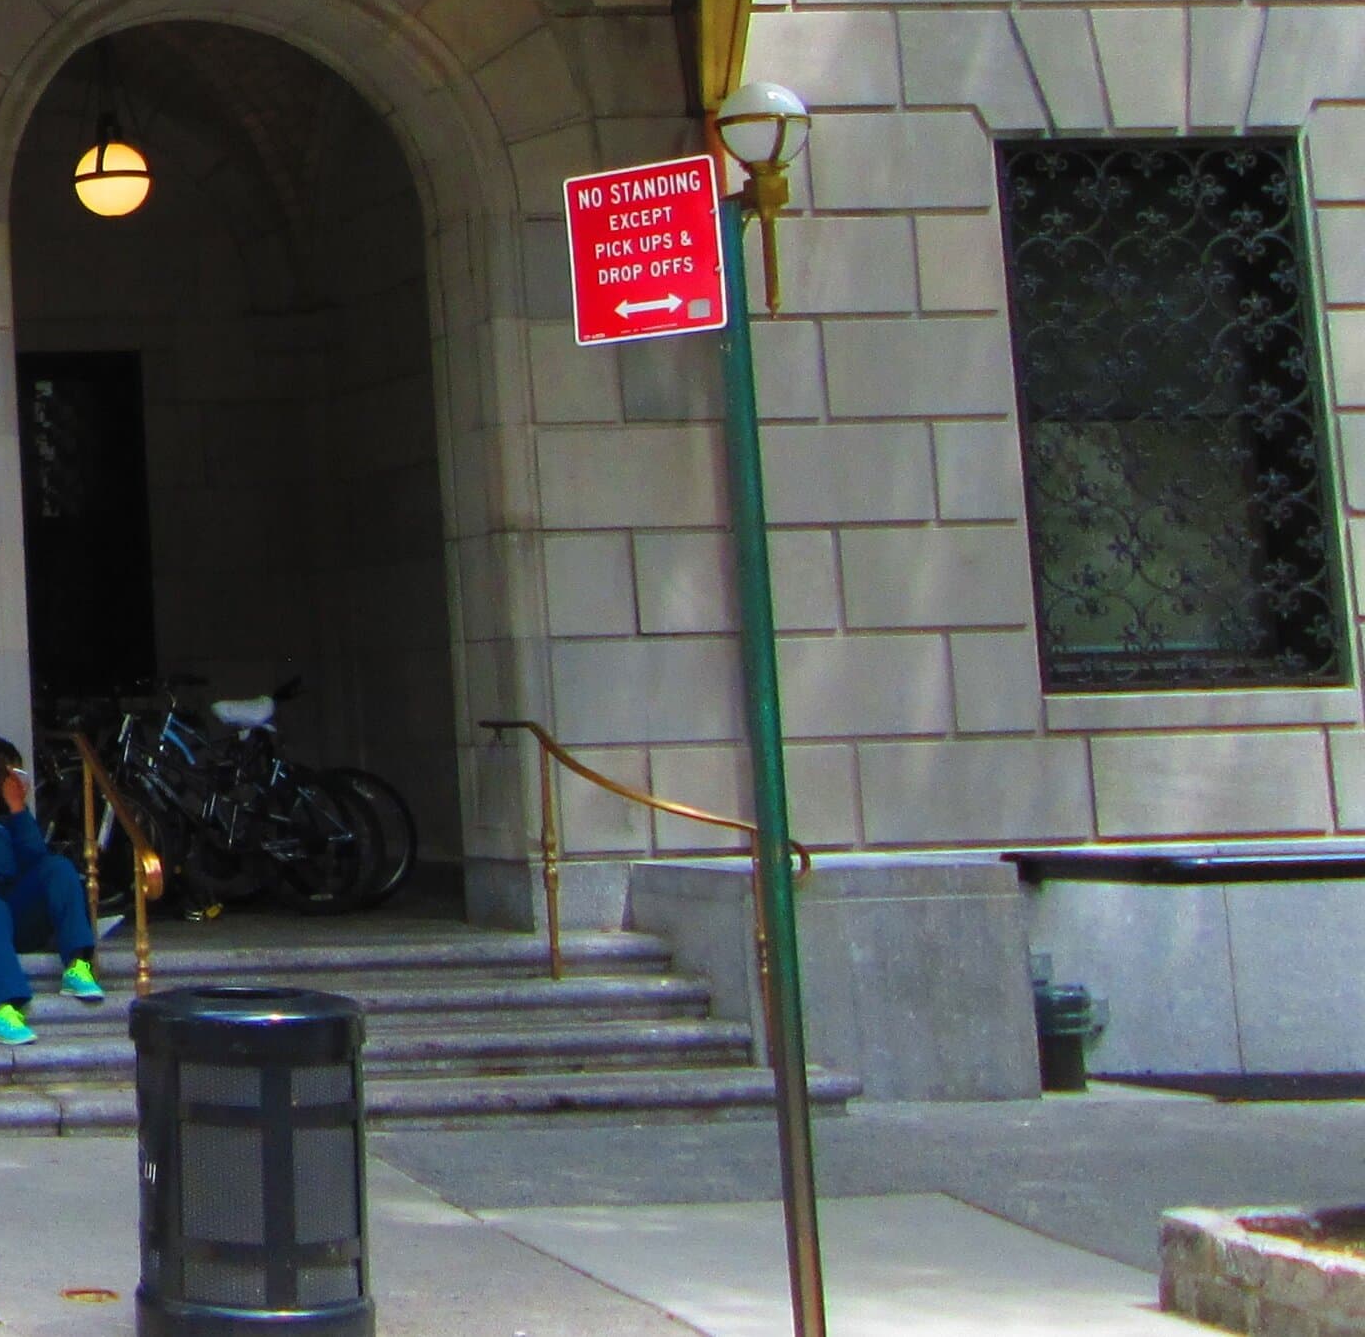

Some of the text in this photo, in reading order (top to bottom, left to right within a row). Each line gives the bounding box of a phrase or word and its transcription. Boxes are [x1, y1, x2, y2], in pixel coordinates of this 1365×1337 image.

[577, 170, 701, 211] NO STANDING
[608, 205, 673, 232] EXCEPT
[594, 229, 693, 260] PICK UPS &
[597, 256, 694, 286] DROP OFFS
